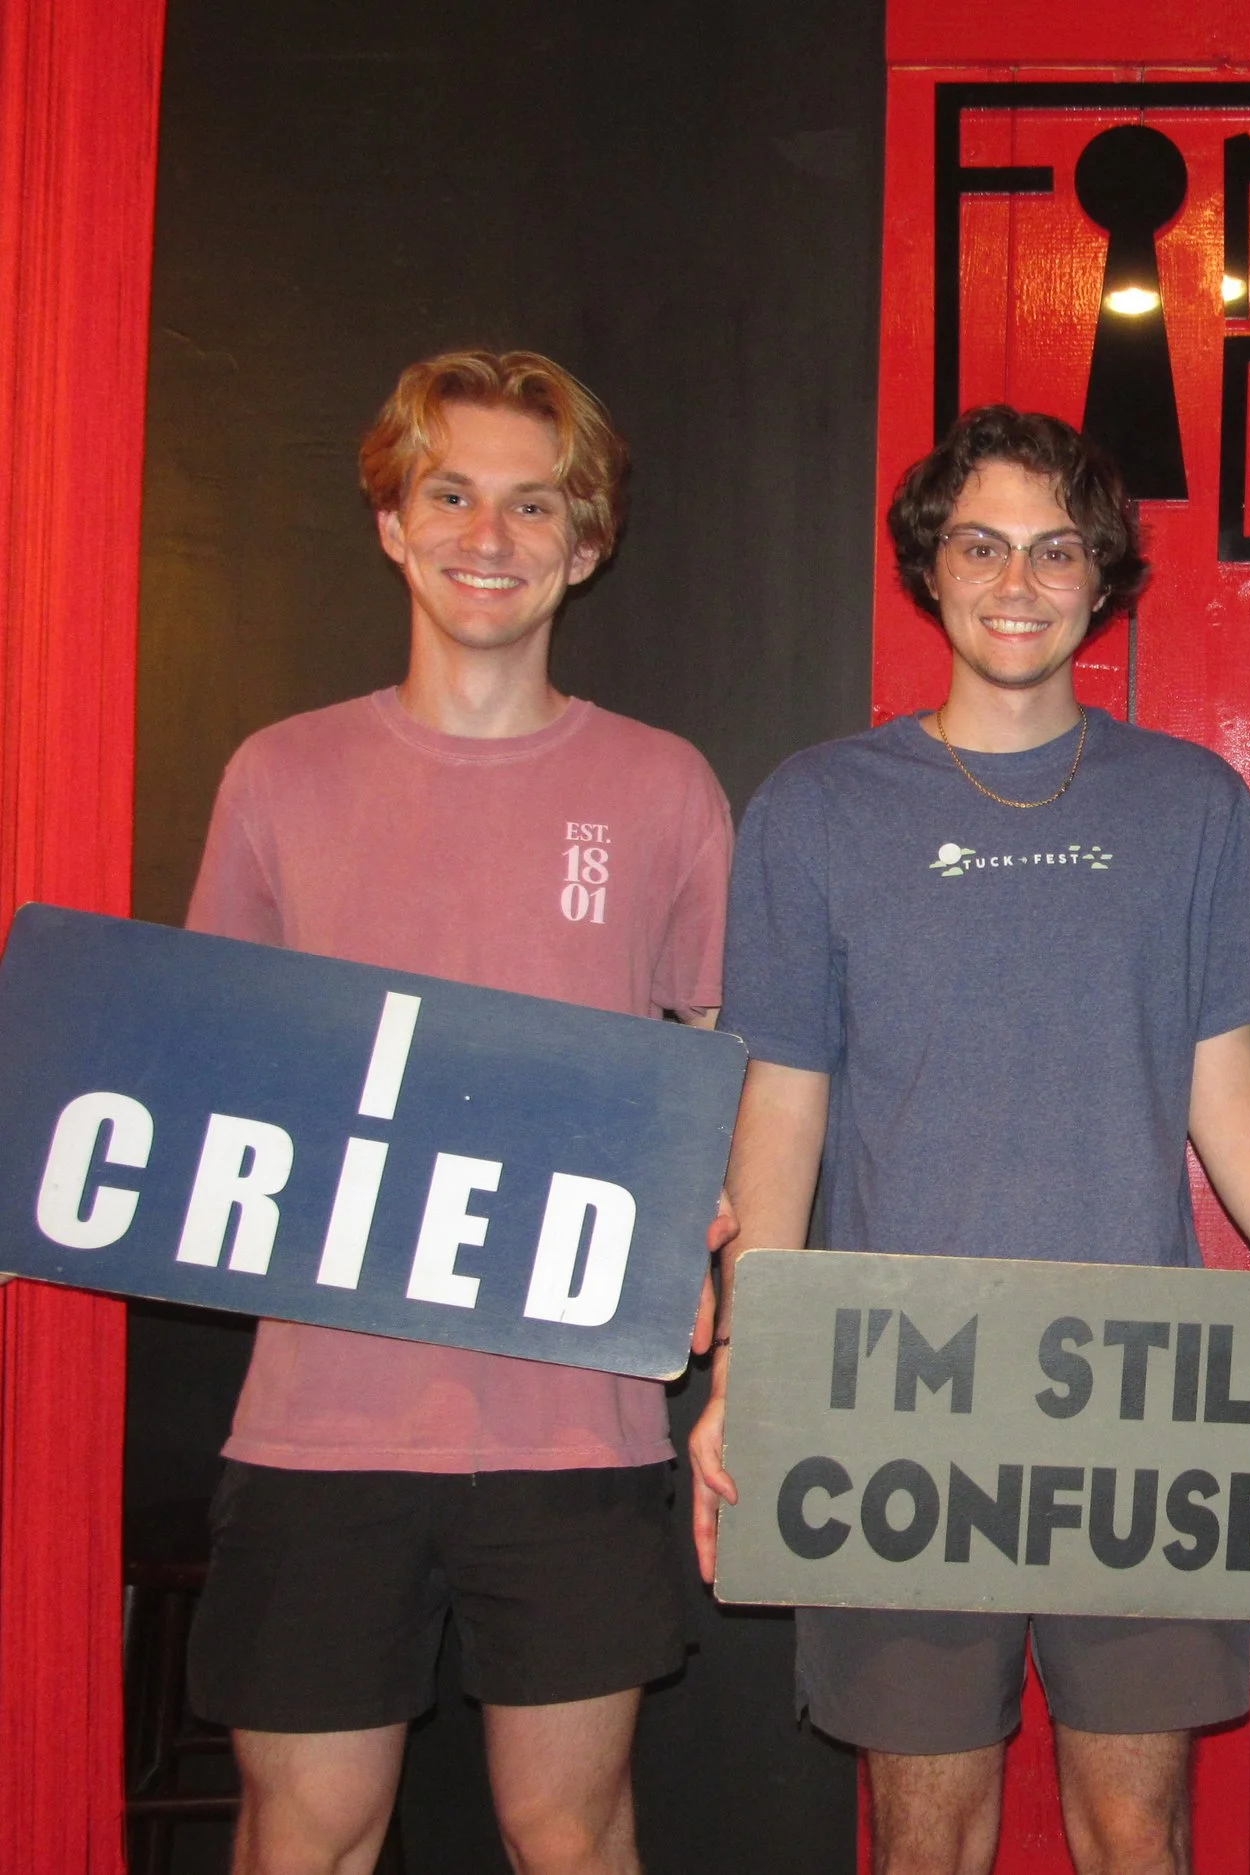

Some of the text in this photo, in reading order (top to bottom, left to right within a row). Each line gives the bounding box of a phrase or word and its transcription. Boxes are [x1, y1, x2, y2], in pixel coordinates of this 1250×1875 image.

[566, 821, 612, 844] EST.
[562, 845, 609, 885] 18
[962, 853, 1080, 870] TUCK FEST
[560, 883, 606, 925] 01
[358, 991, 422, 1121] I
[36, 1091, 638, 1328] CRIED
[829, 1308, 979, 1414] I'M
